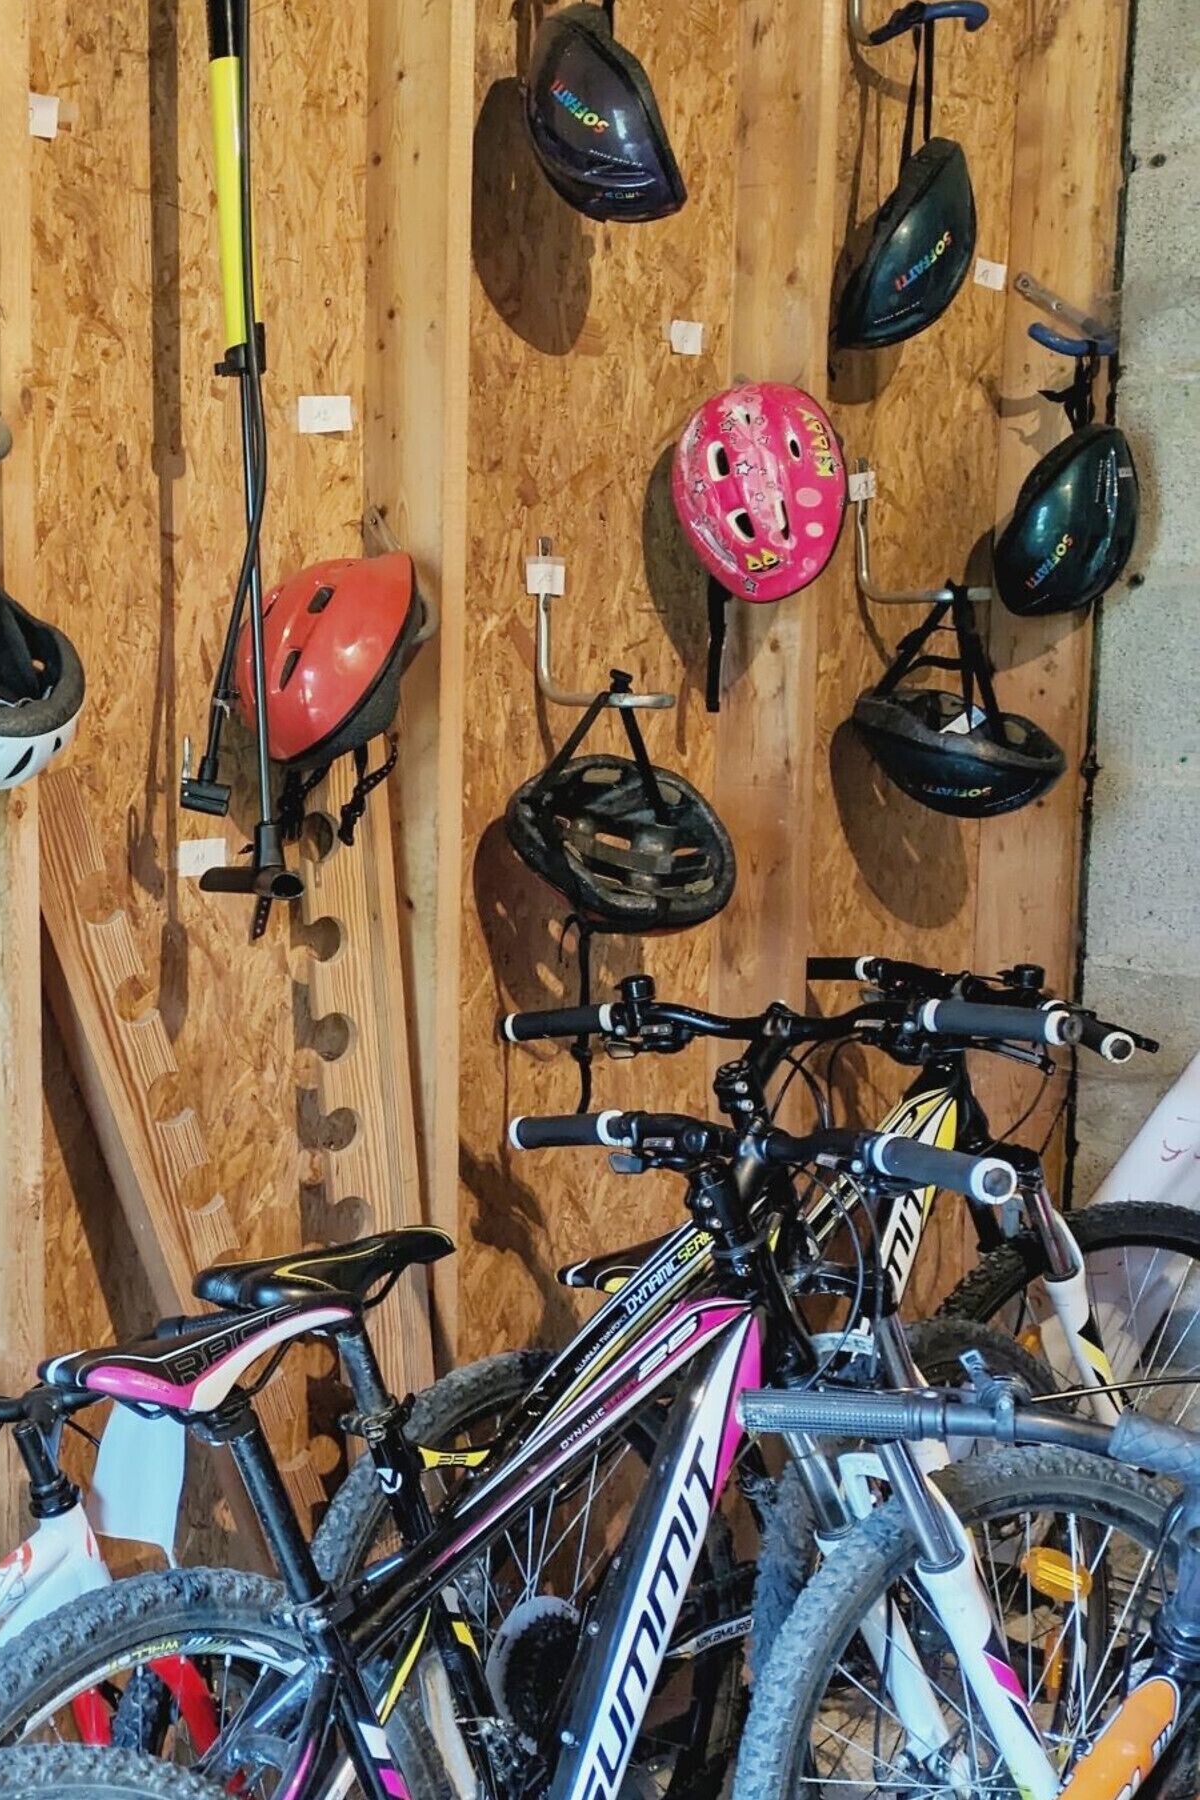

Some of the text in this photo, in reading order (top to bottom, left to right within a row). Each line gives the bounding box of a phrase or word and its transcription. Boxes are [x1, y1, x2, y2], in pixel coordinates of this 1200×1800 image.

[895, 230, 954, 291] SOFFATTI
[1024, 533, 1074, 589] SOFFATTI
[560, 1407, 606, 1450] DYNAMIC
